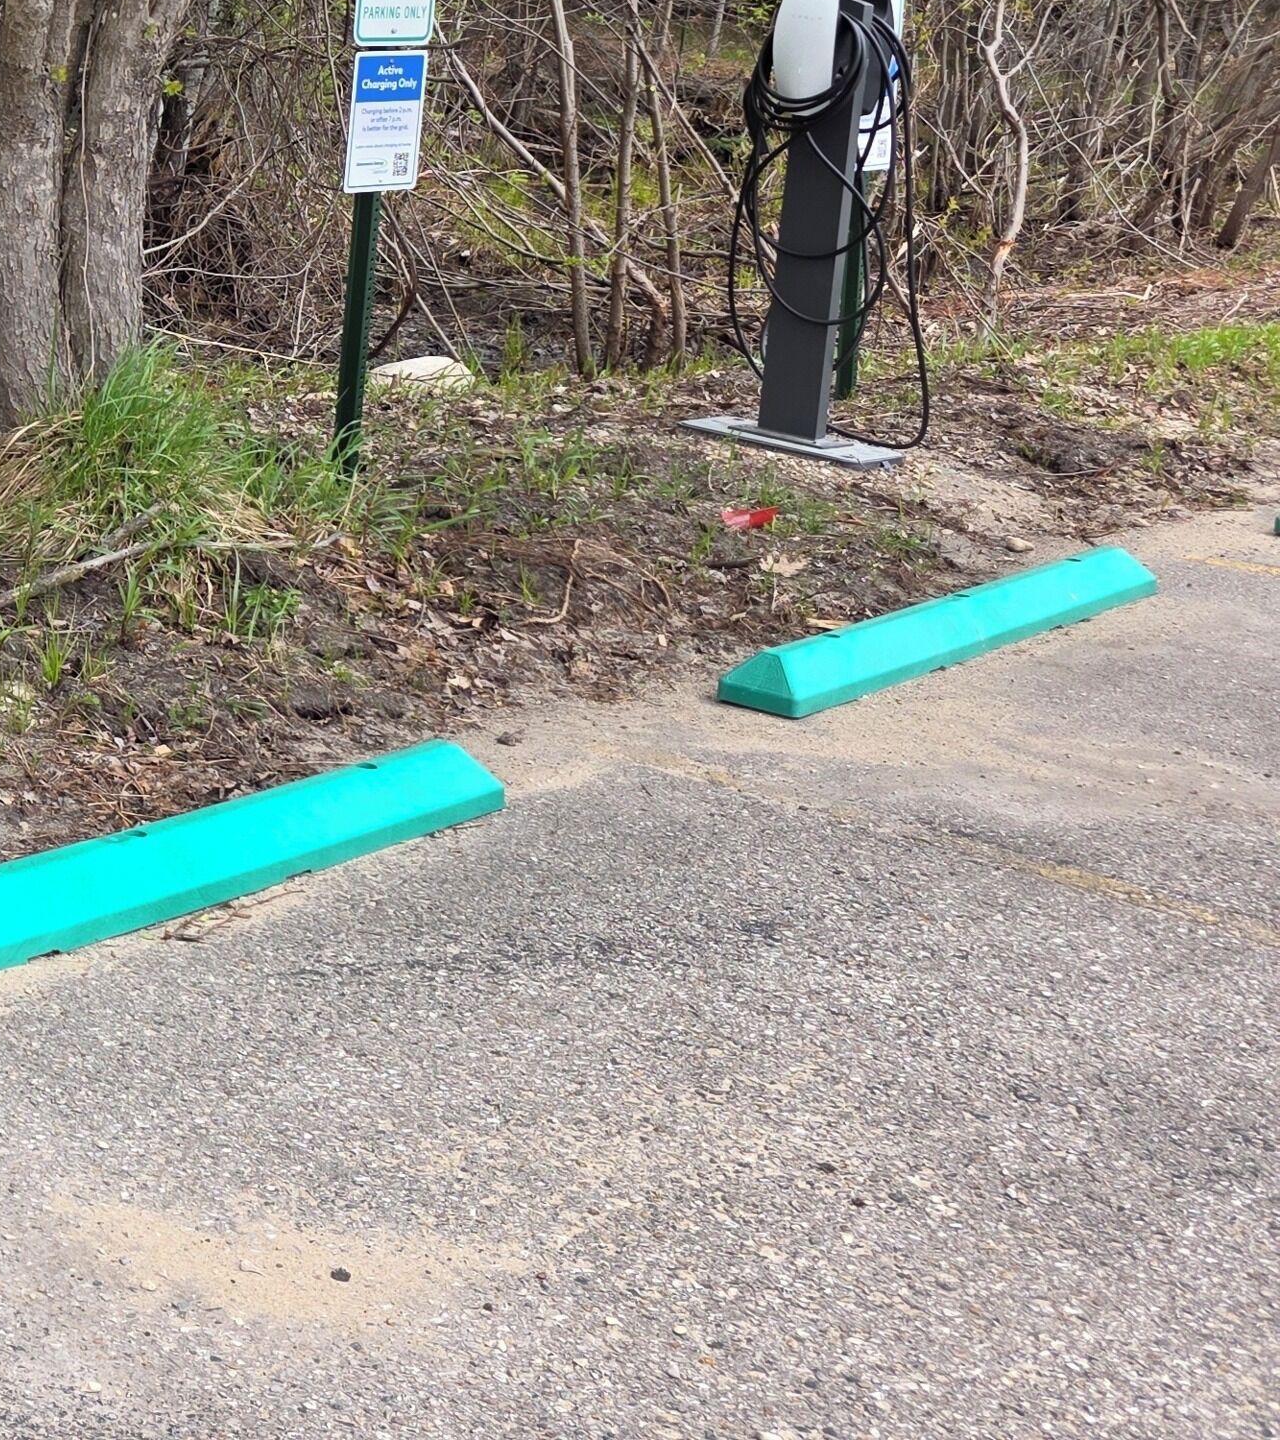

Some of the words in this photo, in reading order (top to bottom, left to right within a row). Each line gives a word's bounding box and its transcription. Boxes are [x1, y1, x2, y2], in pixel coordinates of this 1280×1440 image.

[362, 6, 401, 19] PARKING
[403, 6, 427, 19] ONLY
[377, 65, 403, 76] Active
[361, 79, 397, 91] Charging
[398, 77, 417, 90] Only
